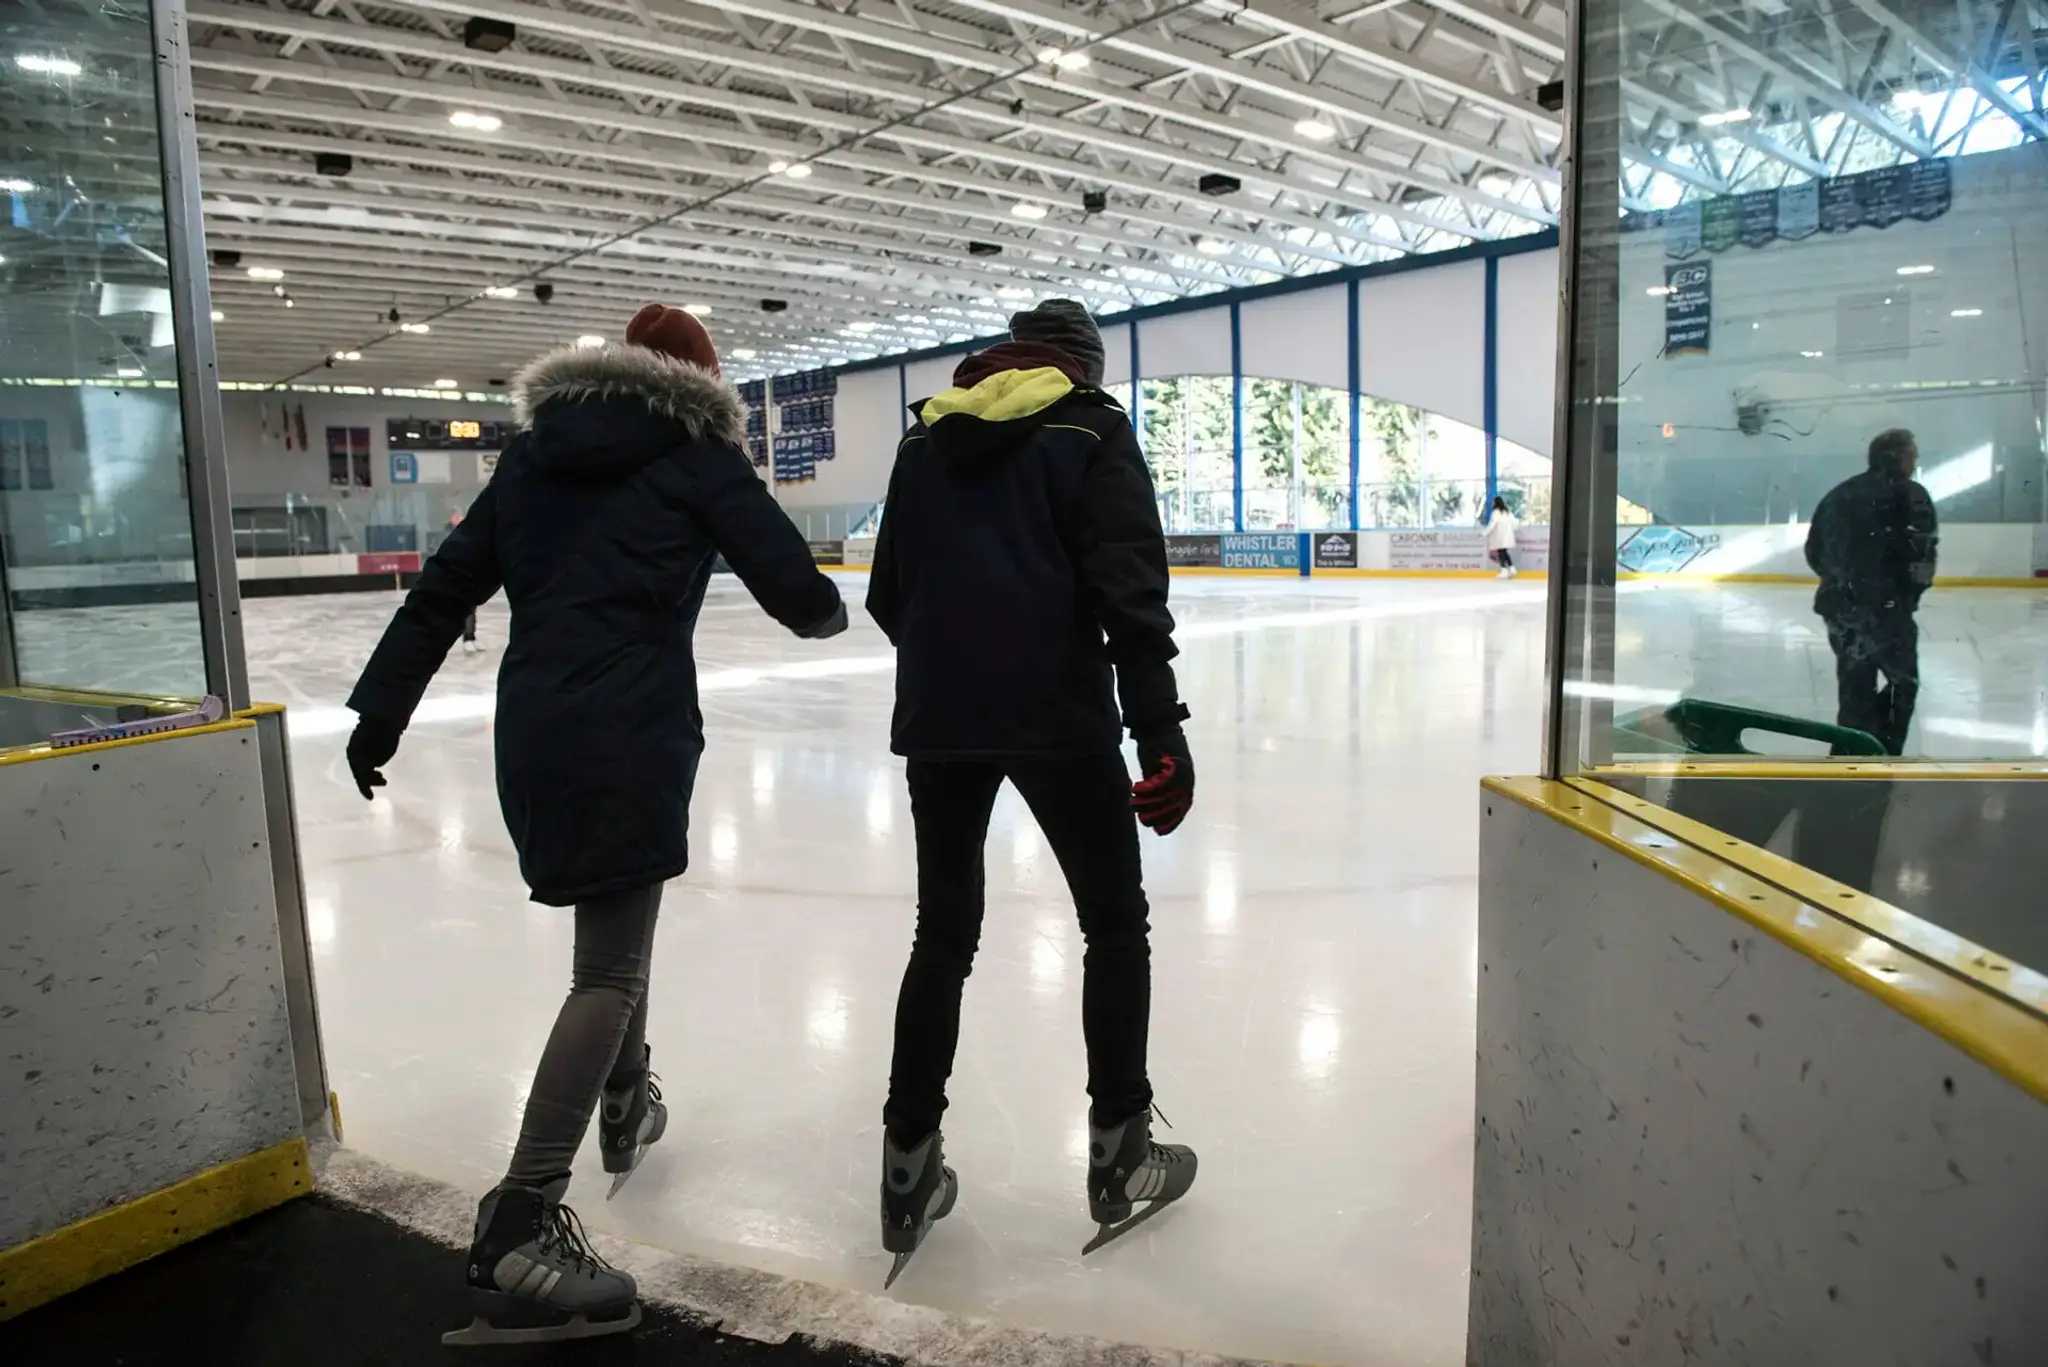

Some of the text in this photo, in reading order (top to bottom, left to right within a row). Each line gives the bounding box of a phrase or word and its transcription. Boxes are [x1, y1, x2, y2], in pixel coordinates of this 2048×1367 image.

[1224, 535, 1297, 550] WHISTLER
[1224, 553, 1279, 568] DENTAL
[1099, 1187, 1110, 1202] A
[903, 1213, 913, 1229] A
